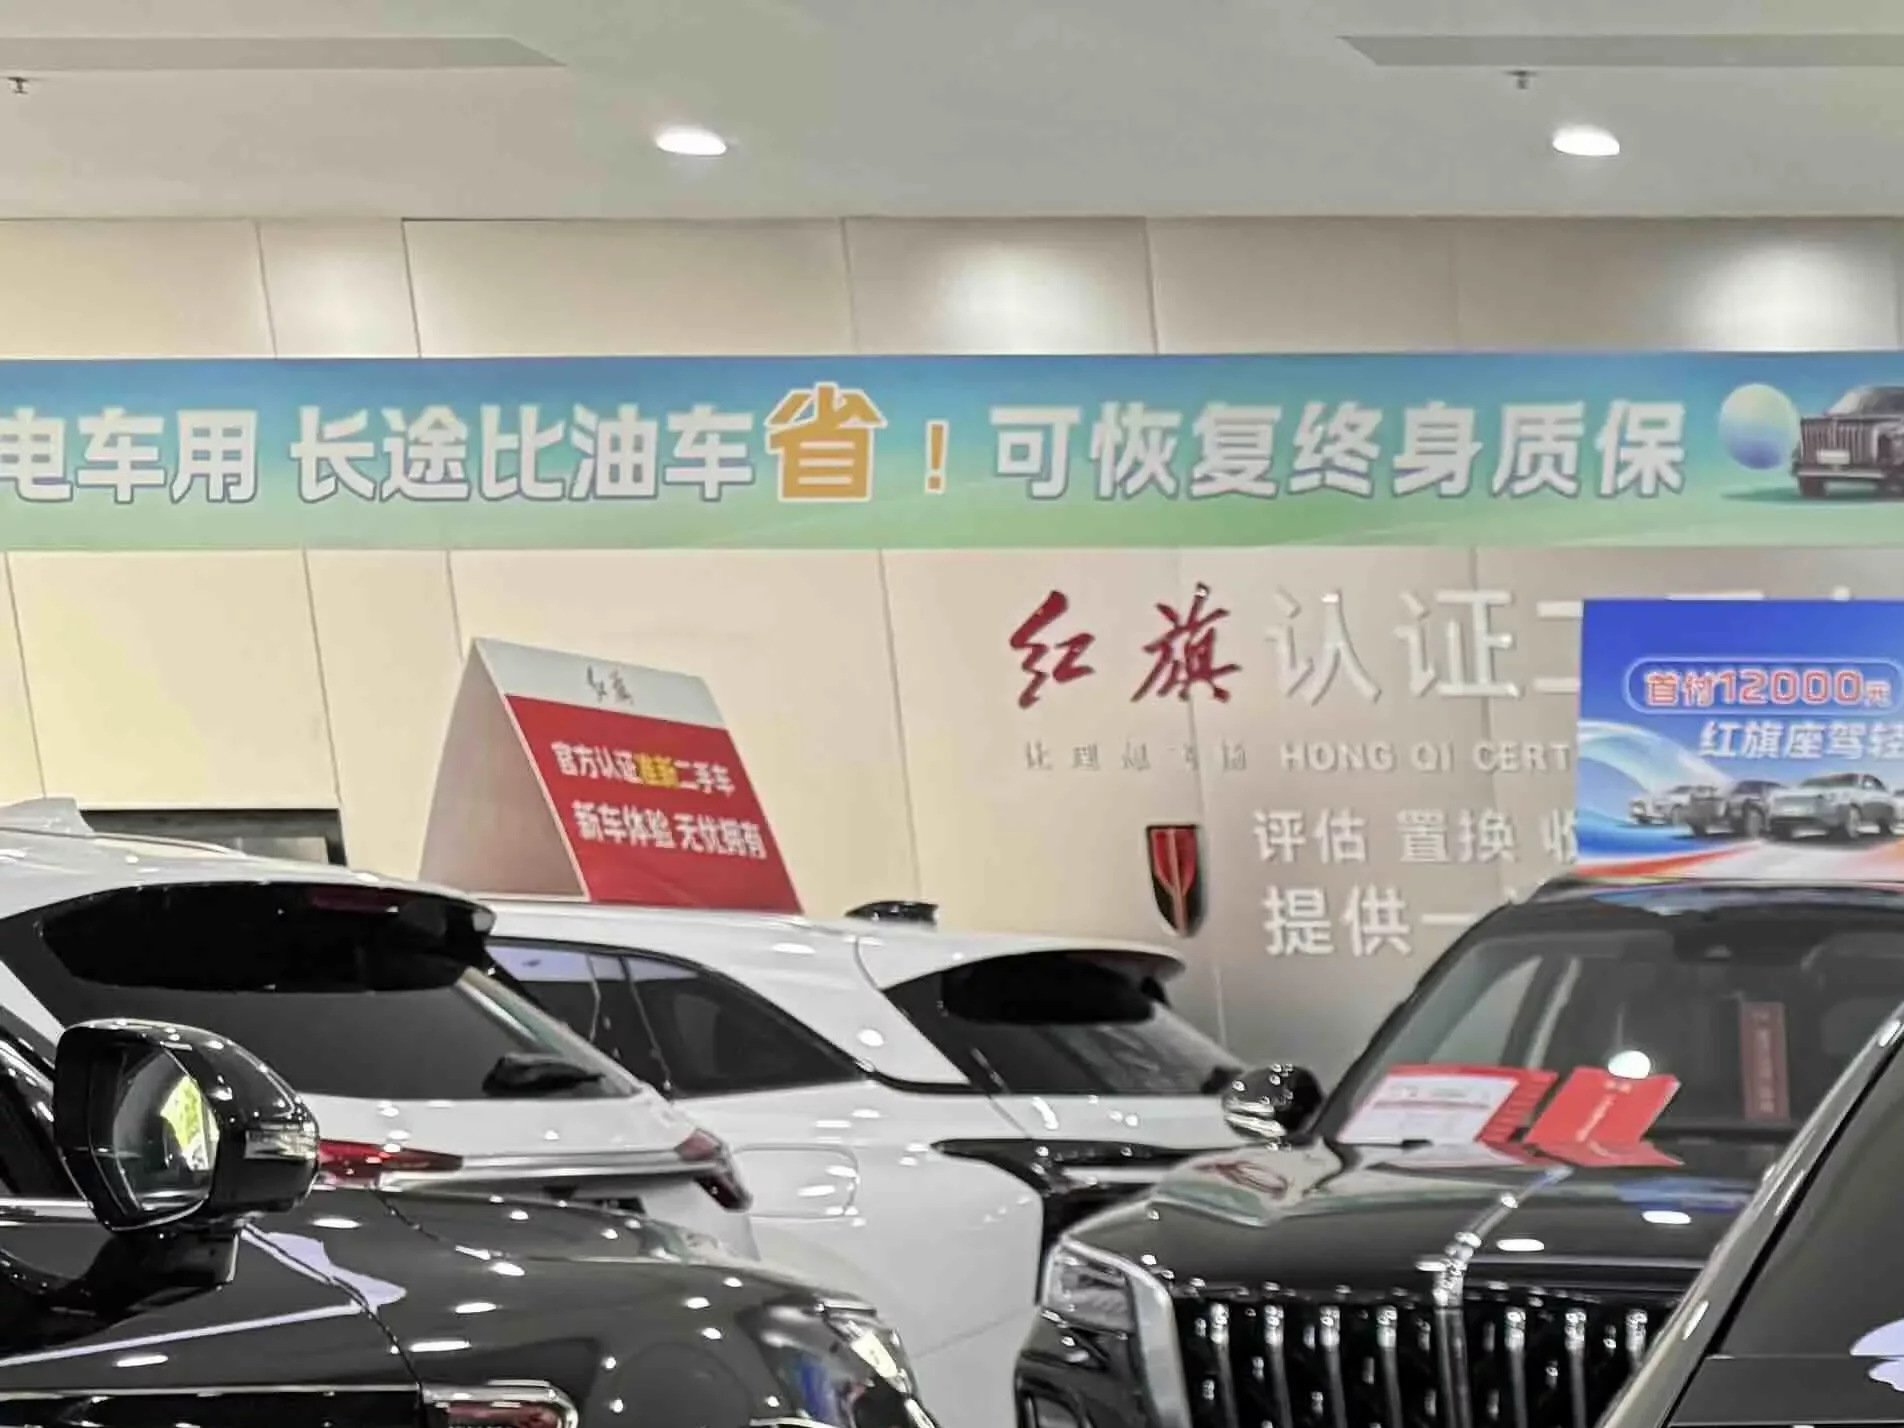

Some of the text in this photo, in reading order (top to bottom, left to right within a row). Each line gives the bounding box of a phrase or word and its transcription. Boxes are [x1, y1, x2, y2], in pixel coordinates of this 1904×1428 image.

[0, 407, 259, 506] 电车用
[987, 399, 1687, 504] 可恢复终身质保
[1280, 742, 1394, 772] HONG
[1411, 742, 1454, 772] QI
[1252, 809, 1367, 864] 评估
[1399, 809, 1518, 864] 置换
[1262, 886, 1517, 957] 提供一
